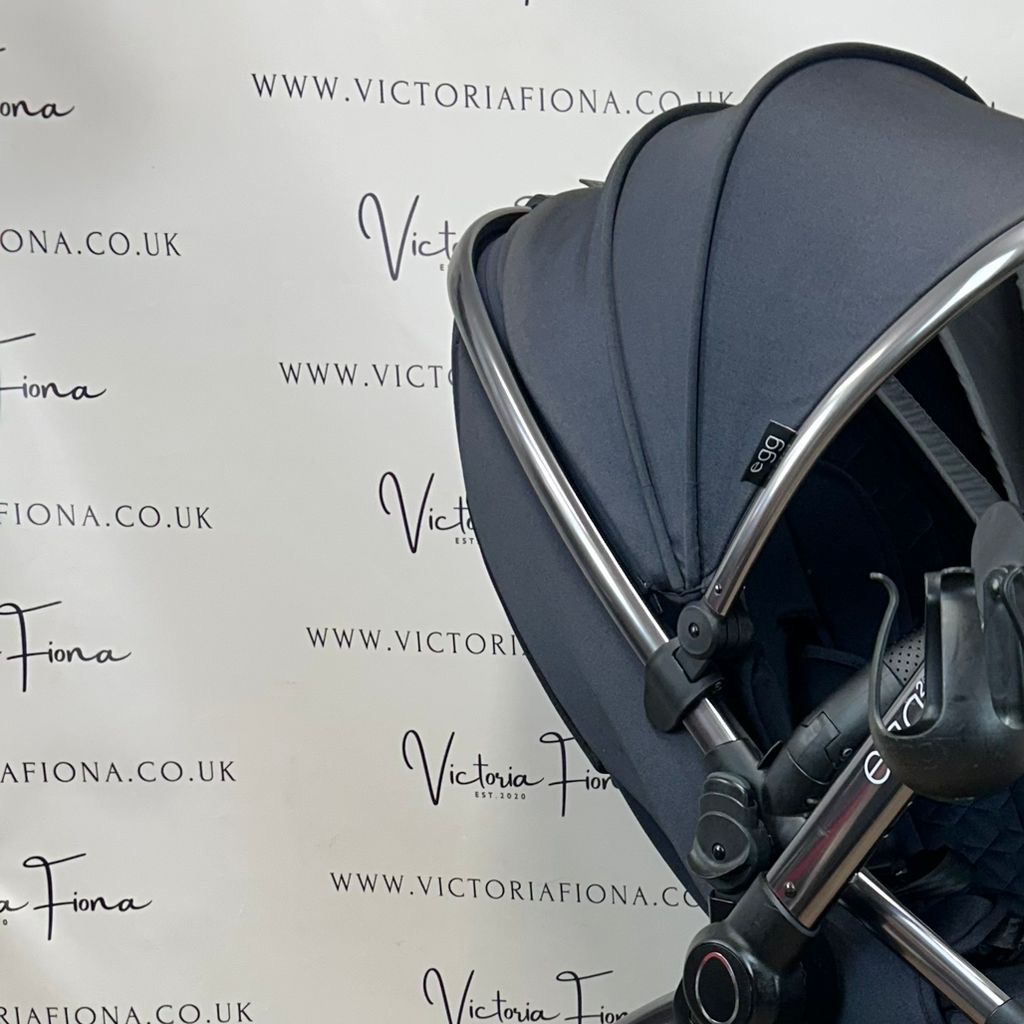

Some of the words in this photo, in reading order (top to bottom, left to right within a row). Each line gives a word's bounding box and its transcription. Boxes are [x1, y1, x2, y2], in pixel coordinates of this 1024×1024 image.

[749, 434, 785, 473] egg
[306, 627, 525, 657] WWW.VICTORI
[402, 729, 544, 806] Victoria
[474, 790, 526, 801] EST.2020
[23, 853, 152, 941] Fiona
